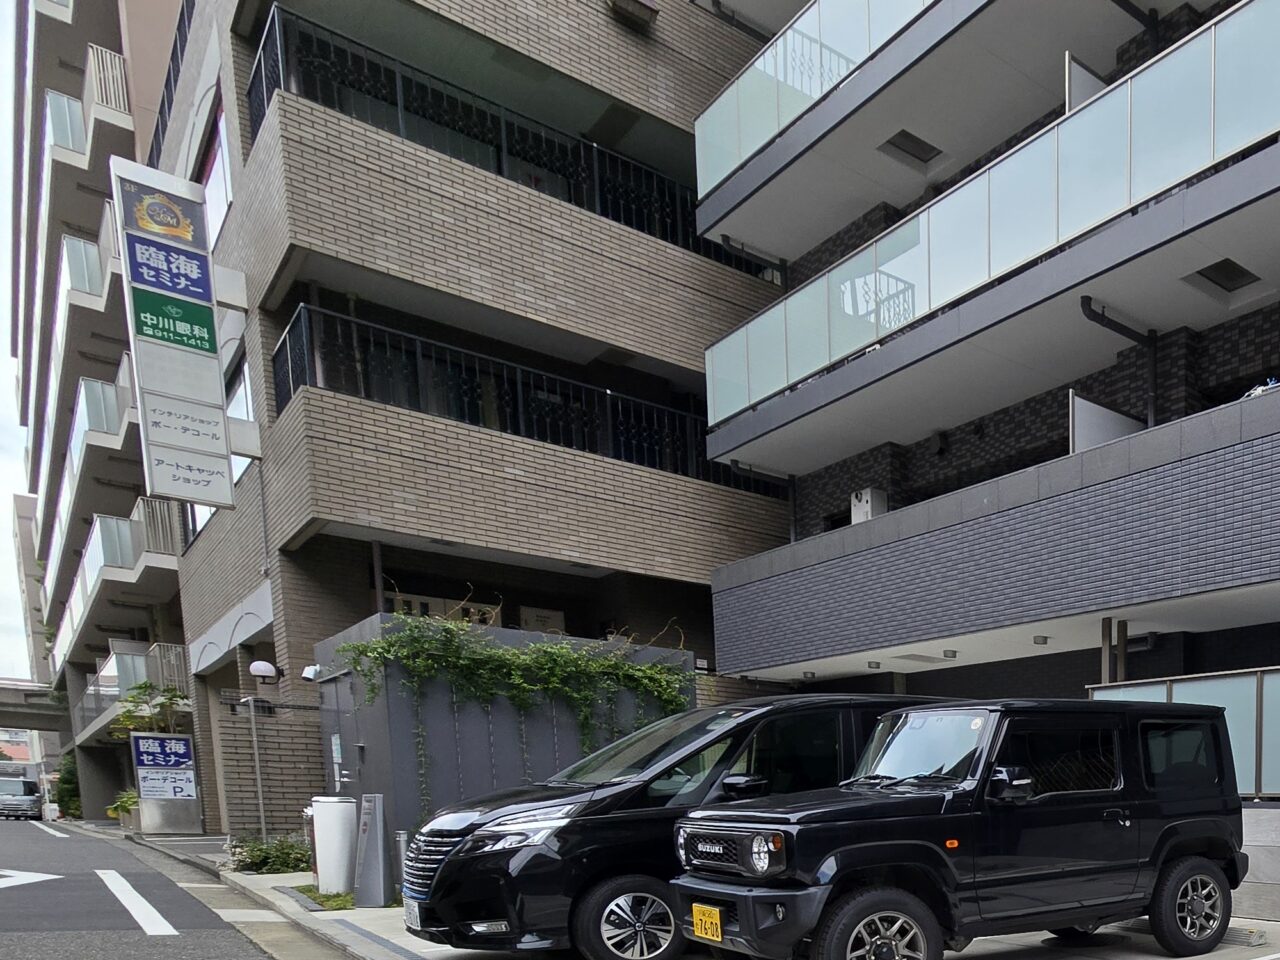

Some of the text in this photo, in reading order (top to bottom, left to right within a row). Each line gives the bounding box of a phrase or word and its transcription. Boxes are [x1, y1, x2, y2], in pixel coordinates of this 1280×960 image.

[135, 243, 202, 279] 臨海
[139, 265, 204, 293] セミナー
[140, 312, 209, 340] 中川眼科
[154, 329, 209, 349] 911-1413
[172, 474, 212, 487] ショップ
[138, 739, 187, 753] 臨海
[140, 753, 189, 765] セミナー
[172, 785, 184, 797] P
[697, 842, 723, 854] SUZUKI
[699, 918, 719, 938] 76-08
